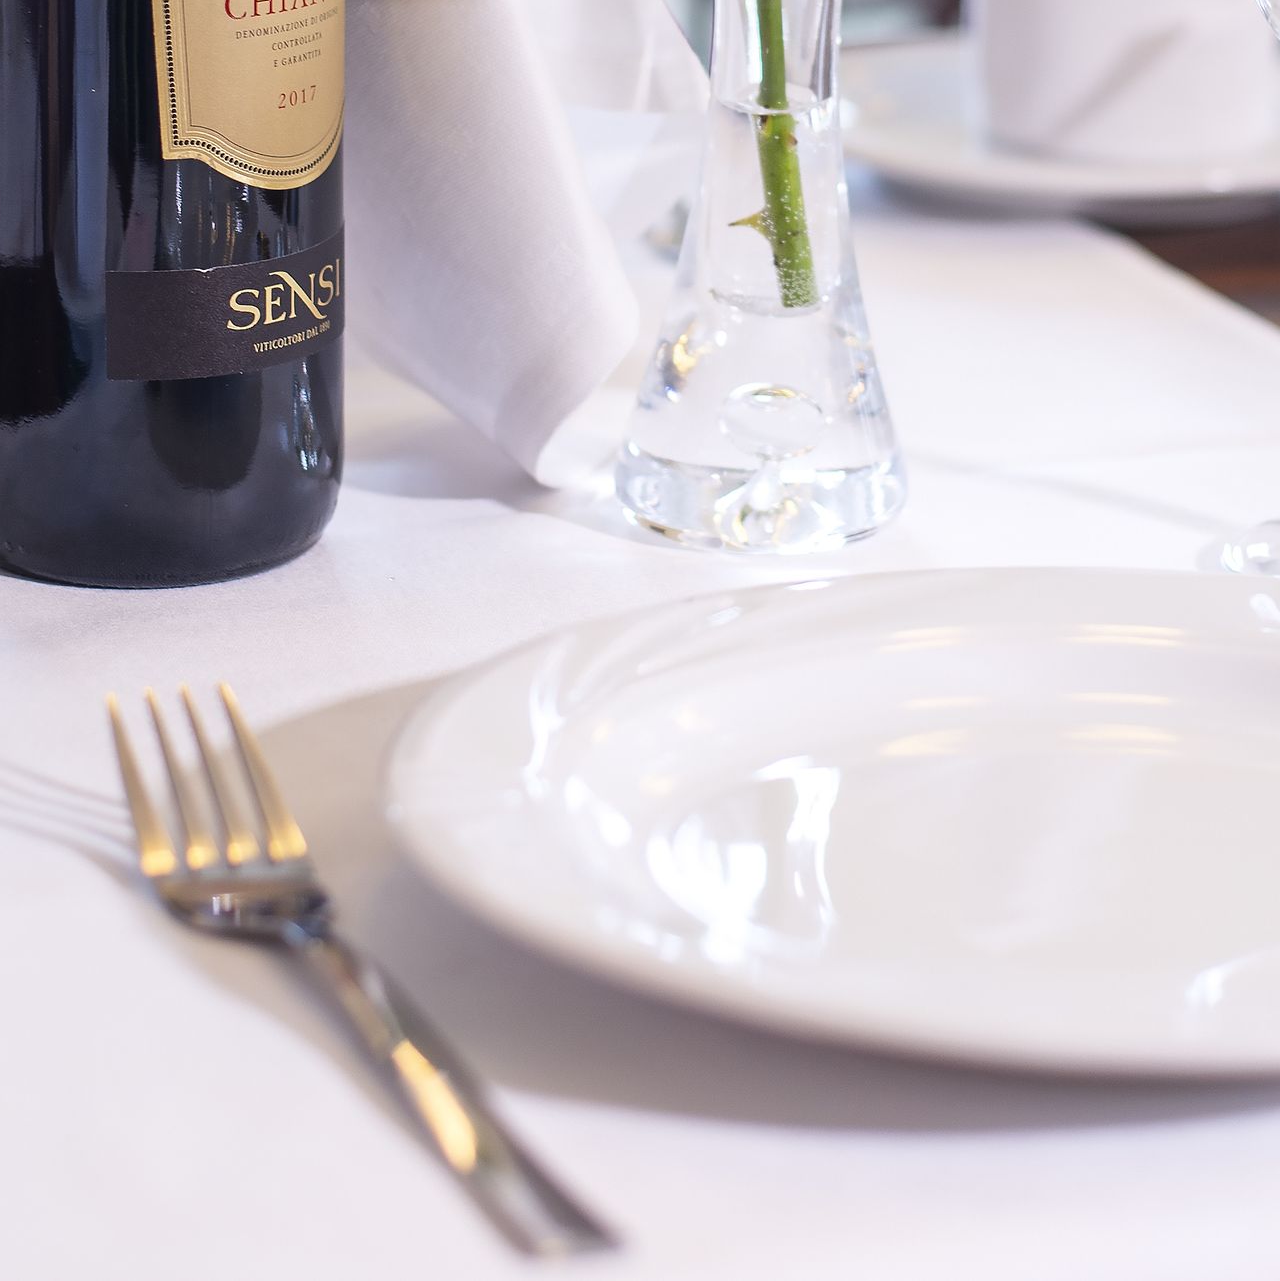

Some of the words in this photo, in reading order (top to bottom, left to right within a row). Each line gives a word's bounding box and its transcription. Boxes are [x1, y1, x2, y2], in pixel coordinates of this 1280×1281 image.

[235, 18, 308, 39] DENOMINAZIONE
[271, 31, 322, 51] CONTROLLATA
[274, 60, 278, 68] E
[281, 49, 322, 66] GARANTITA
[278, 85, 317, 109] 2017
[226, 258, 340, 331] SENSI
[253, 331, 305, 353] VITICOLTORI
[306, 326, 318, 339] DAL
